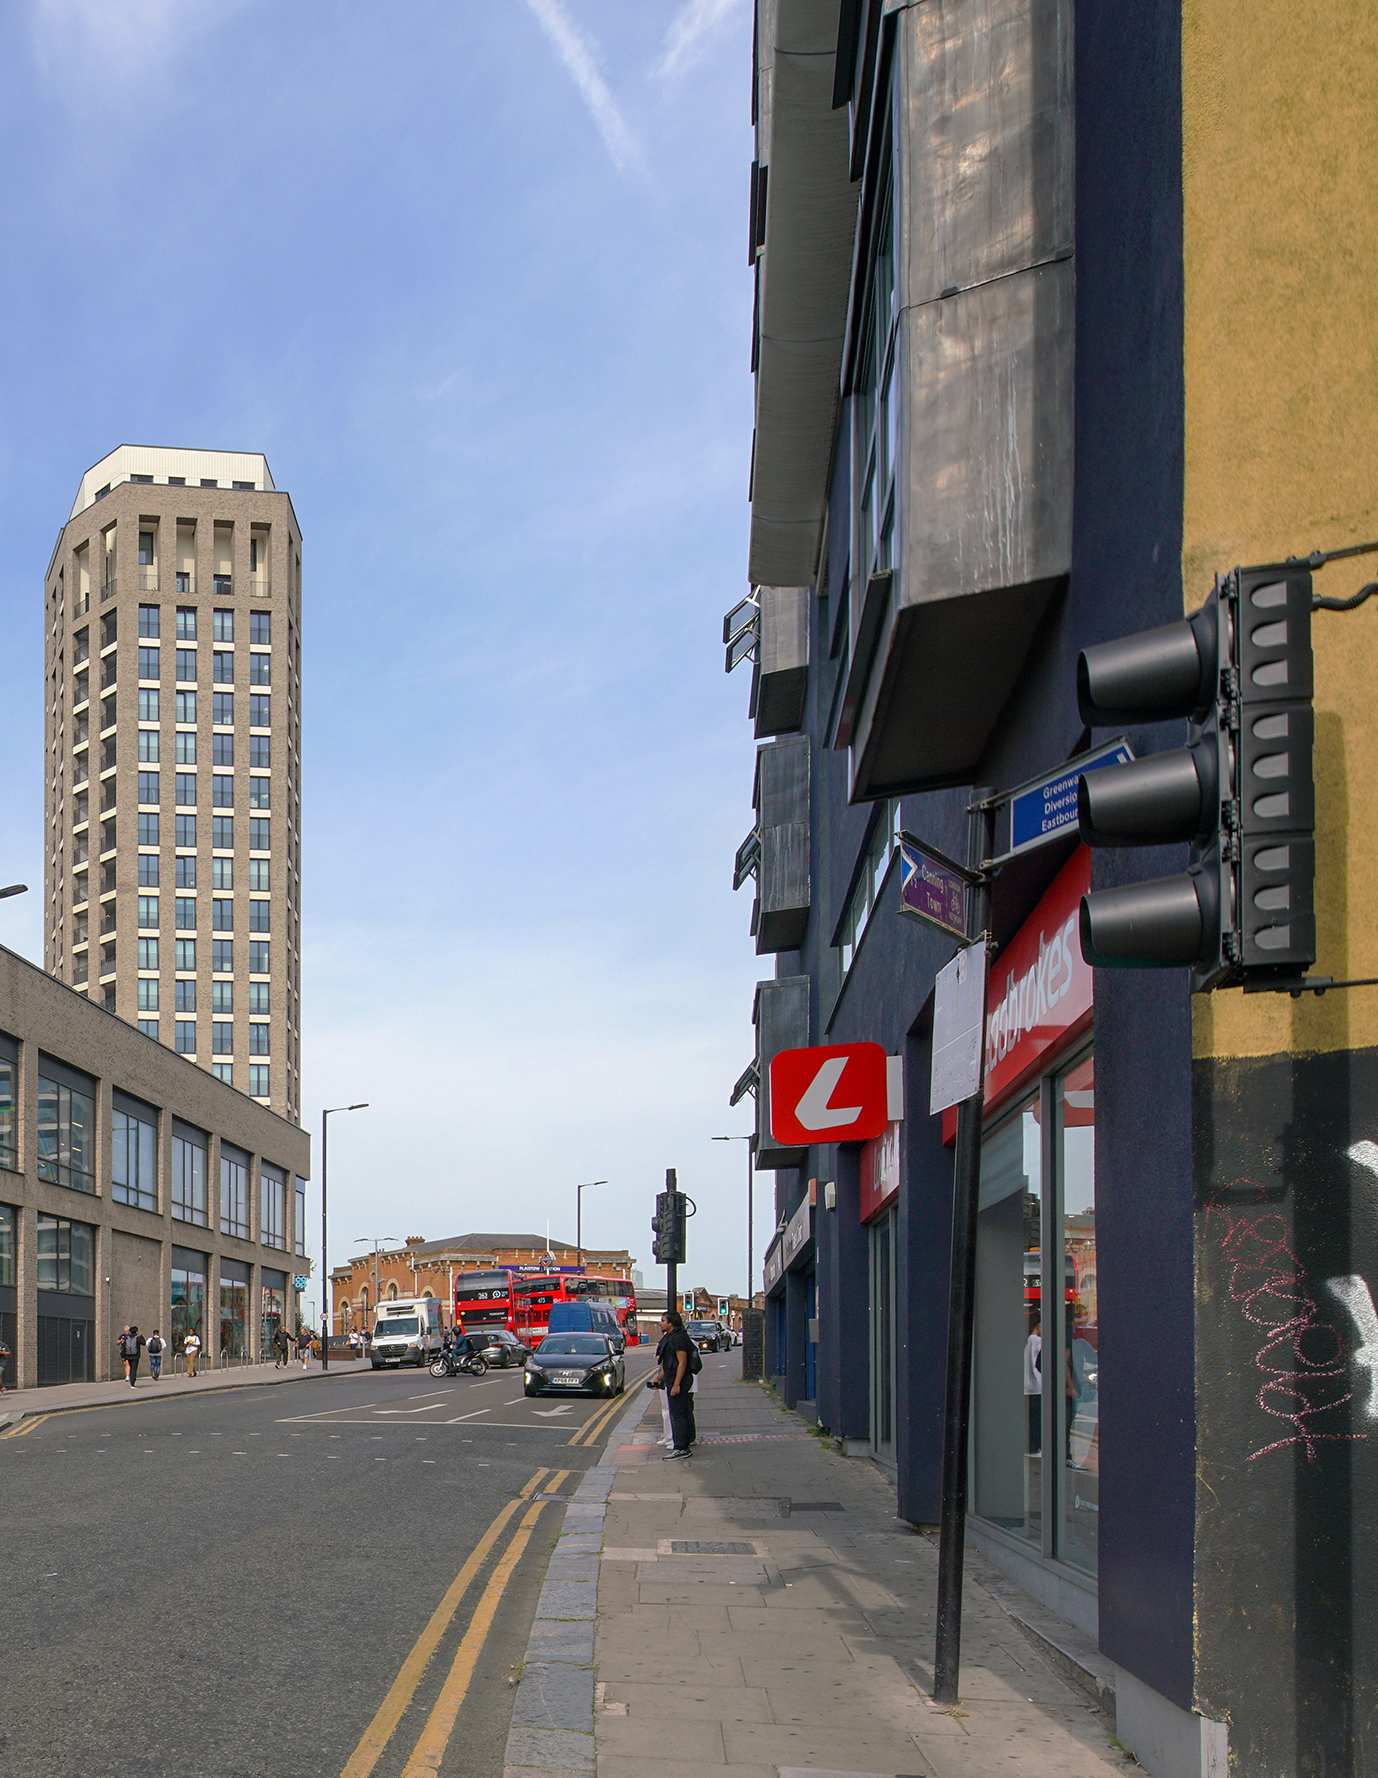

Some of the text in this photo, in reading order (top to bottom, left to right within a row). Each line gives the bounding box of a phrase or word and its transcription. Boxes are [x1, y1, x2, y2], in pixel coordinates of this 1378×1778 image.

[1043, 774, 1081, 799] Greenwa
[1044, 791, 1078, 815] Diversio
[984, 918, 1074, 1077] adbrokes
[794, 1056, 863, 1131] L
